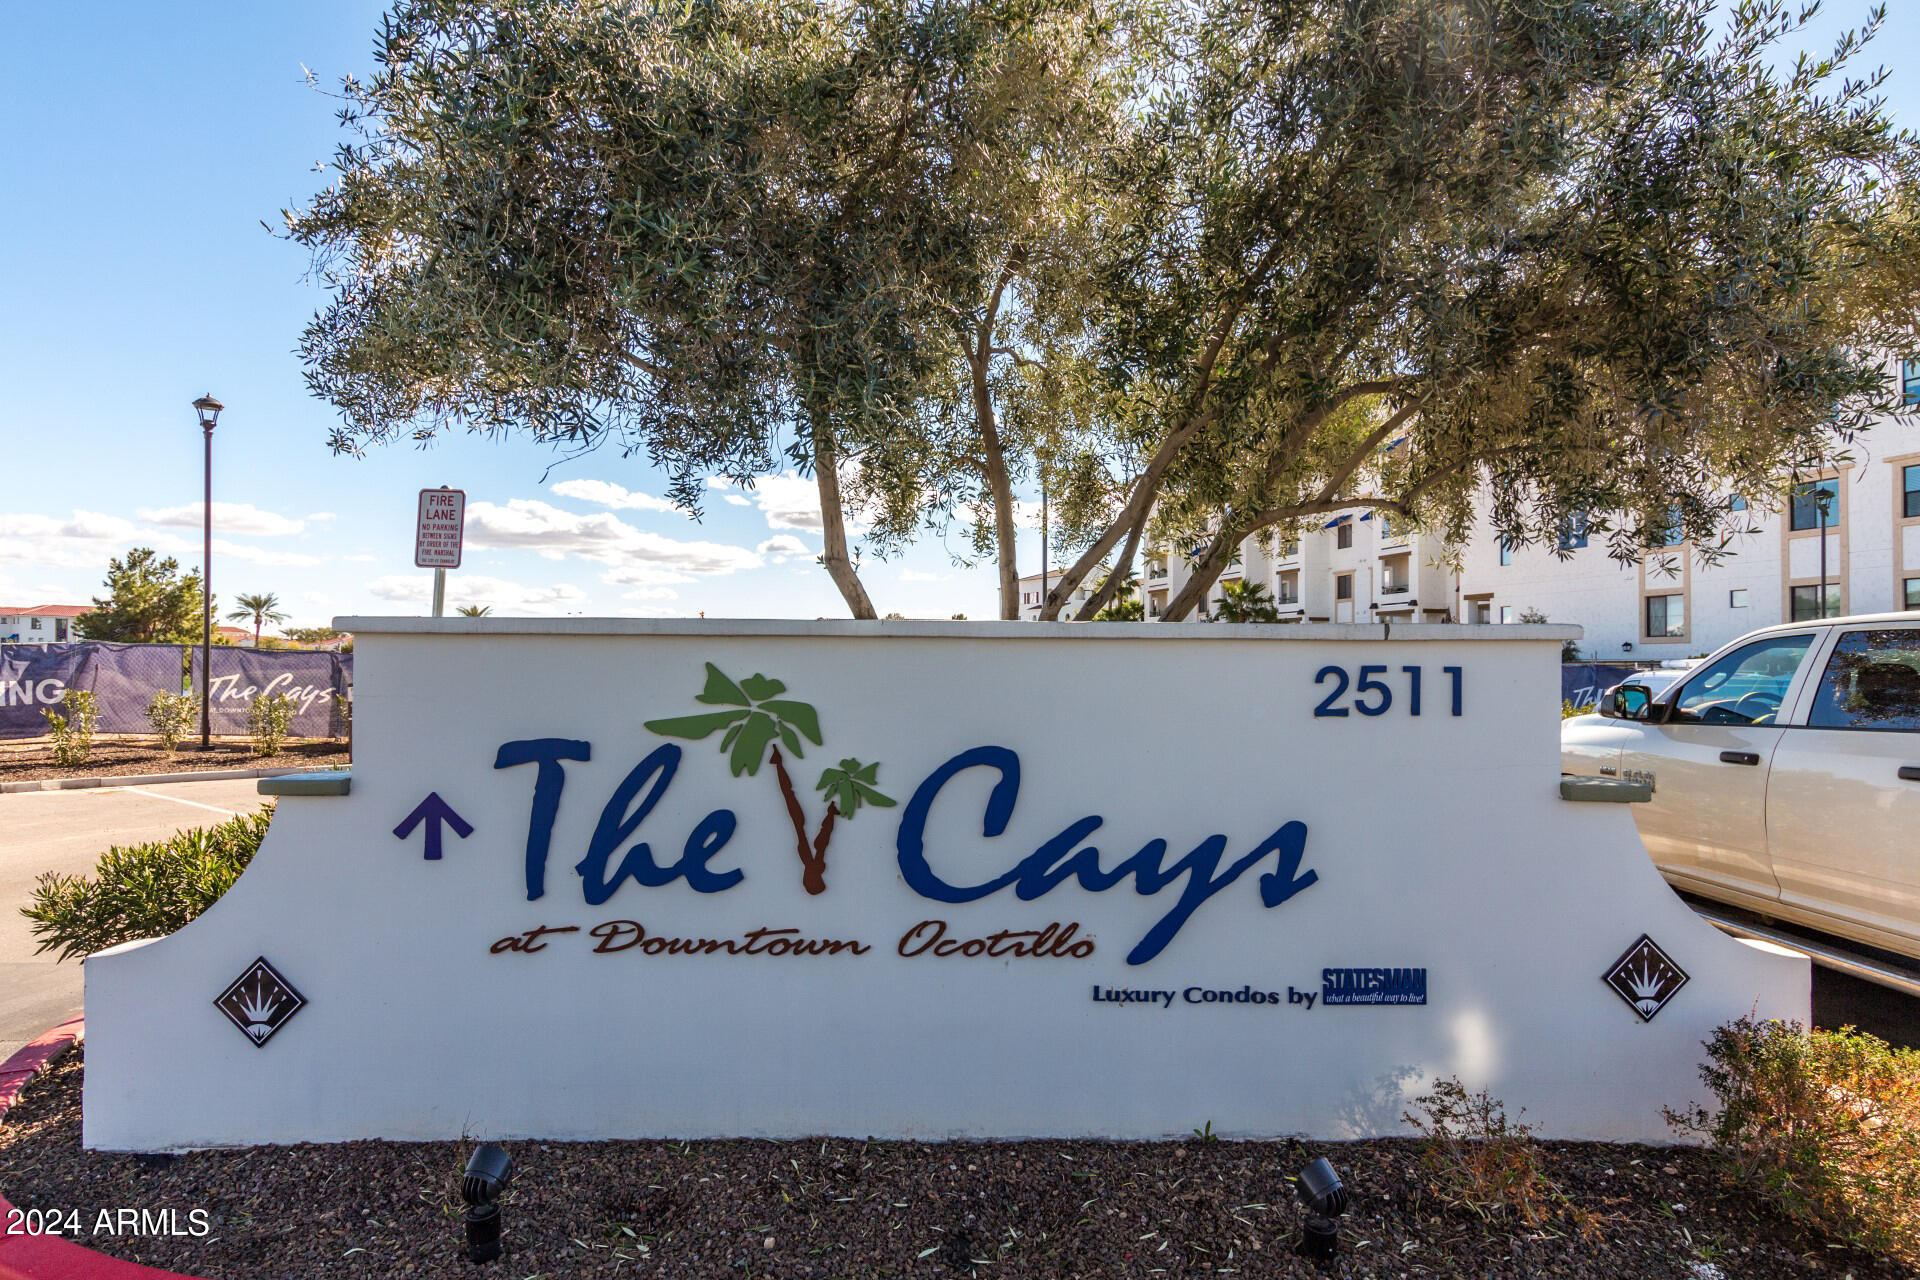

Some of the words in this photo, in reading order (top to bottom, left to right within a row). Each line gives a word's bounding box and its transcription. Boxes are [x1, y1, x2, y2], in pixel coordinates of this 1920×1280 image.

[430, 495, 454, 506] FIRE
[426, 509, 456, 520] LANE
[432, 524, 459, 532] PARKING
[209, 673, 258, 702] The
[1313, 664, 1464, 718] 2511
[494, 737, 745, 906] The
[896, 745, 1319, 967] Cays
[489, 924, 581, 956] at
[589, 919, 871, 958] Downtown
[897, 919, 1096, 959] Ocotillo
[1322, 967, 1428, 990] STATESMAN
[1092, 984, 1177, 1009] Luxury
[1182, 984, 1280, 1005] Condos
[1287, 985, 1319, 1011] by
[1326, 993, 1344, 1003] what
[1352, 992, 1383, 1004] beautiful
[1384, 994, 1399, 1004] way
[1400, 993, 1408, 1002] to
[1408, 993, 1424, 1003] live!
